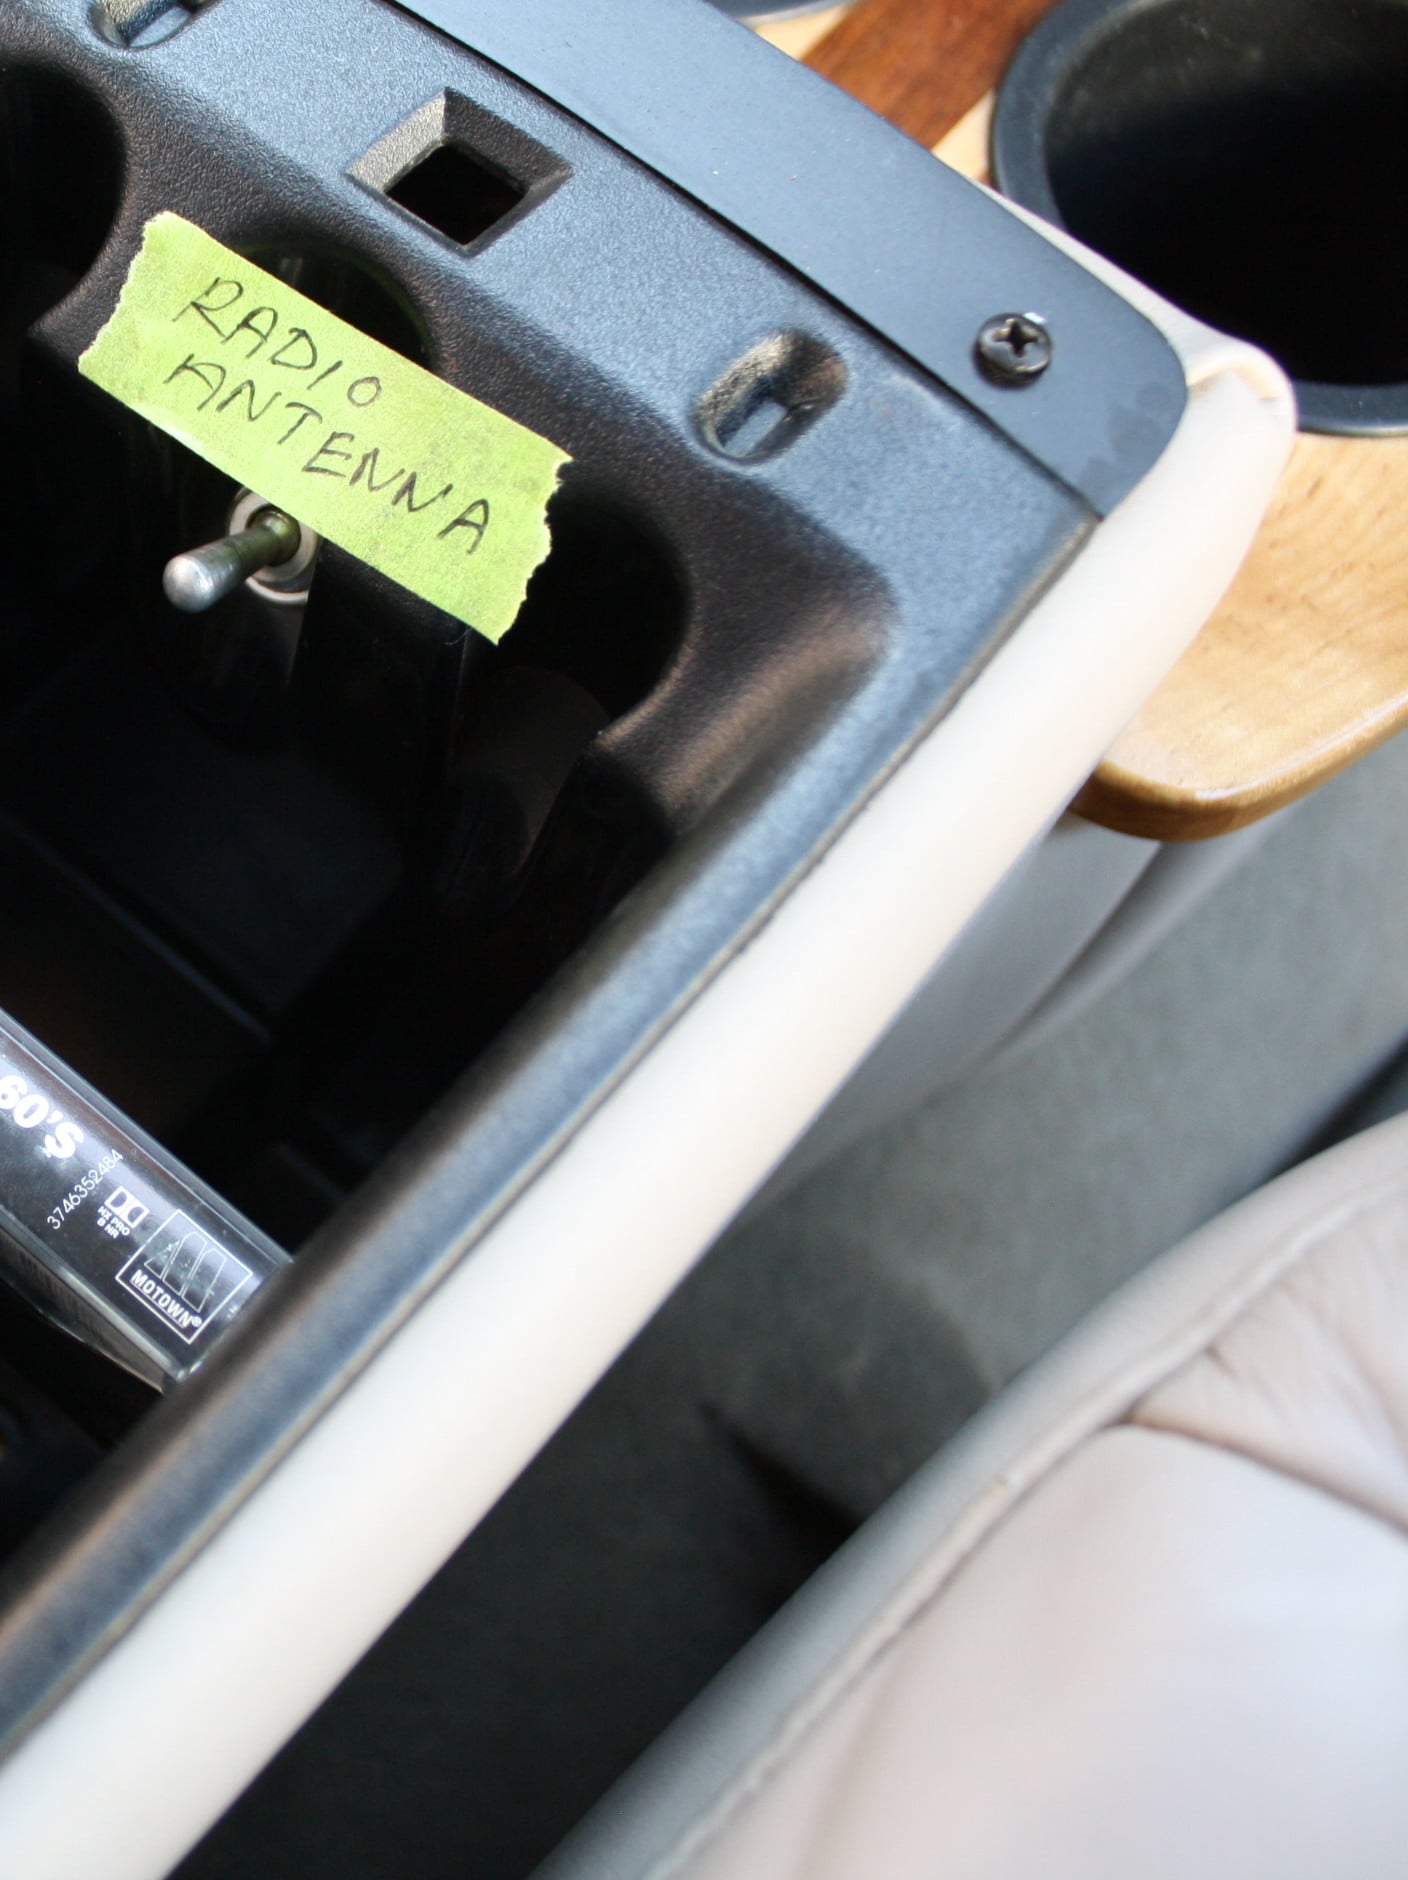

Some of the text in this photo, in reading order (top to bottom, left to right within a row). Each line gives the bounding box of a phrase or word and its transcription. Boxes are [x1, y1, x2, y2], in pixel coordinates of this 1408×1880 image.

[172, 276, 381, 407] RADIO
[163, 354, 491, 555] ANTENNA
[47, 1148, 124, 1230] 3746352484
[111, 1218, 130, 1236] PRO
